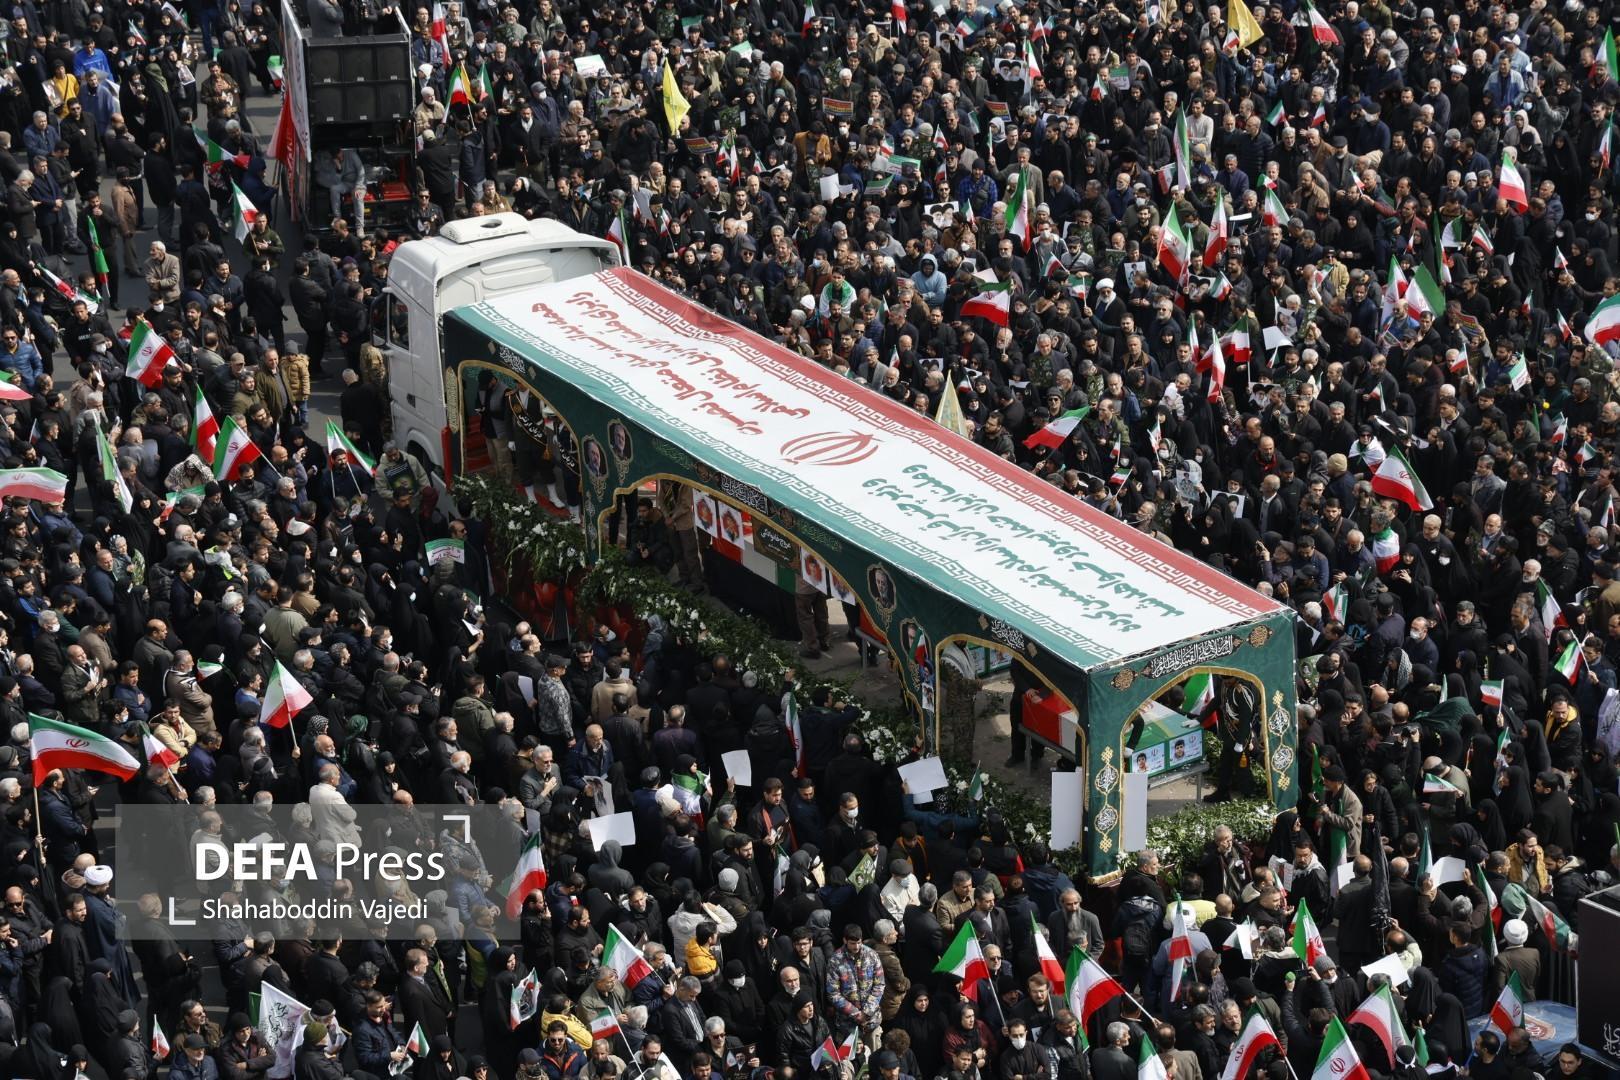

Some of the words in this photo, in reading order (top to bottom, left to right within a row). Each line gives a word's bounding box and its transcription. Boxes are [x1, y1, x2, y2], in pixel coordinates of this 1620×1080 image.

[566, 291, 593, 303] را
[576, 300, 618, 320] برای
[531, 303, 566, 324] همه
[611, 353, 670, 368] خدای
[655, 368, 713, 400] متعال
[692, 401, 762, 434] نصرت
[700, 367, 760, 390] نظام
[733, 389, 810, 418] اسلامی
[867, 485, 913, 500] زیر
[896, 499, 948, 519] چتر
[975, 544, 1047, 572] اسلام
[1019, 573, 1109, 610] تضمین
[1081, 610, 1141, 632] کرده
[911, 472, 955, 495] ملت
[939, 493, 998, 514] ایران
[987, 515, 1034, 537] حتما
[1026, 530, 1088, 560] پیروز
[1069, 561, 1147, 598] خواهد
[1135, 597, 1184, 616] شد
